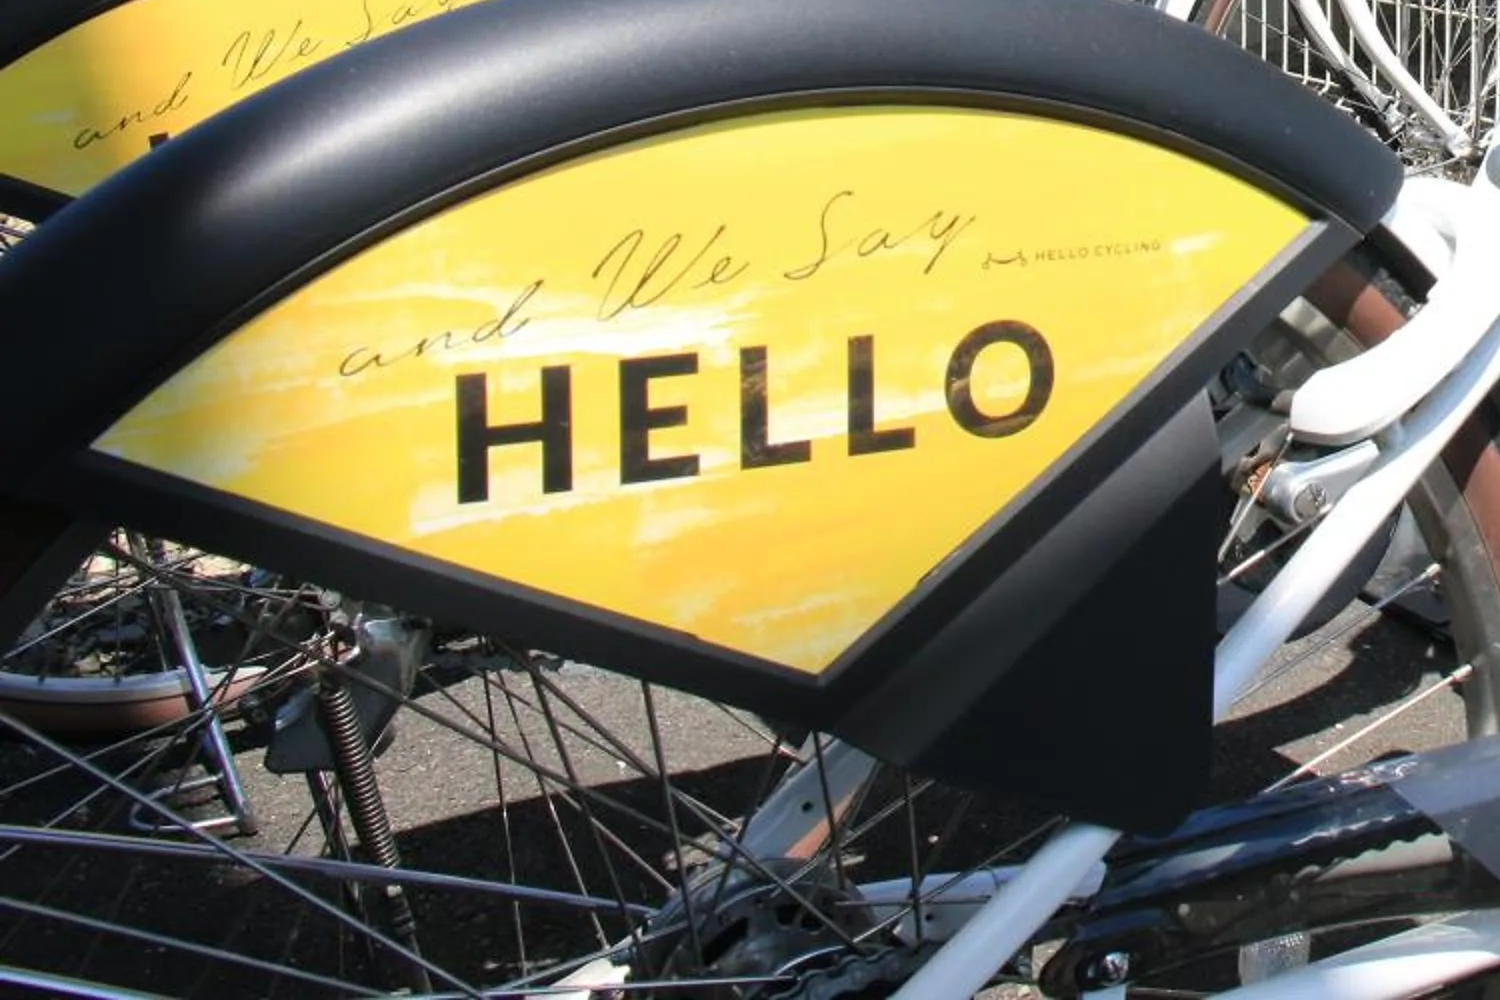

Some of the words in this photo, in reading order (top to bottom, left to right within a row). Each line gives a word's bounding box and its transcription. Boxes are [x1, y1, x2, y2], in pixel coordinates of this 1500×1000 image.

[73, 71, 193, 150] and
[220, 18, 323, 90] We
[338, 278, 545, 377] and
[591, 227, 751, 322] We
[782, 189, 977, 282] Say
[1034, 246, 1090, 262] HELLO
[1093, 239, 1162, 258] CYCLING
[455, 318, 1056, 506] HELLO
